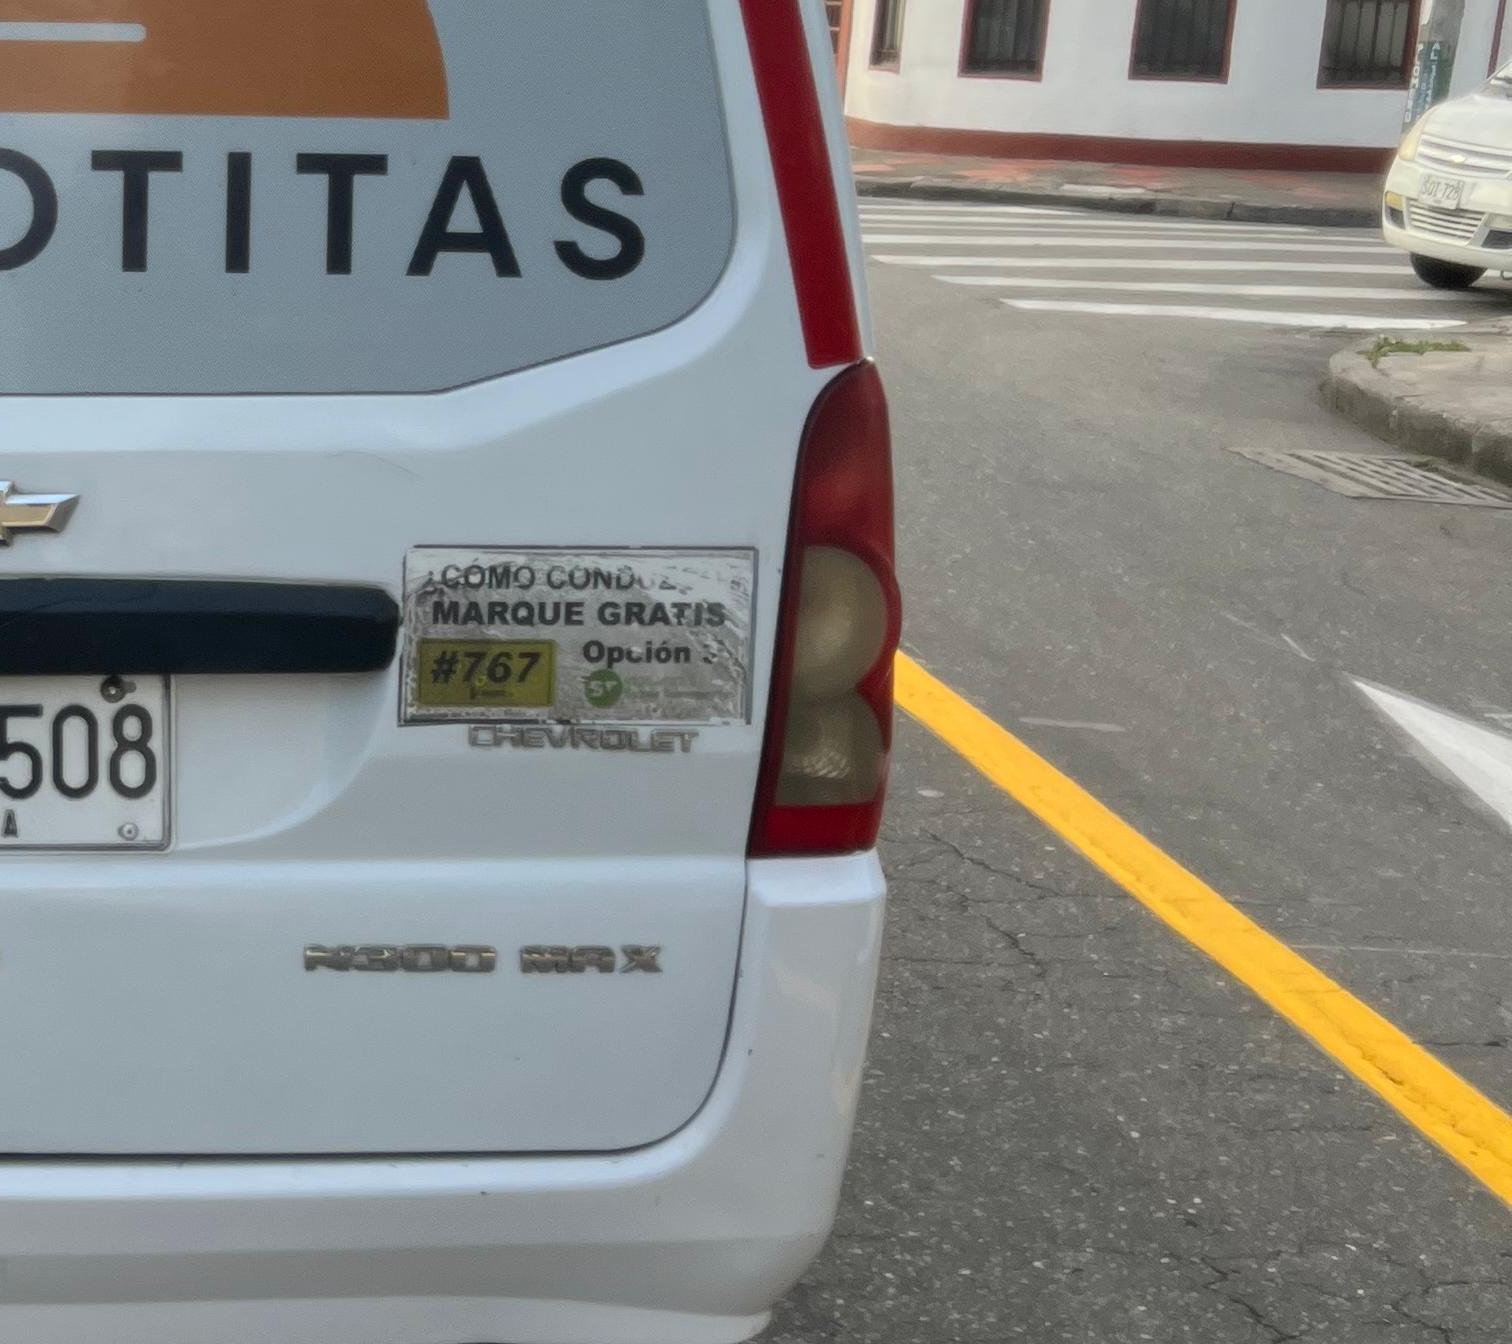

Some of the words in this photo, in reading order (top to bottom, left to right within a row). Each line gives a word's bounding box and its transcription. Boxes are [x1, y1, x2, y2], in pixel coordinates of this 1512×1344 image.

[432, 600, 585, 626] MARQUE
[597, 600, 726, 627] GRATIS
[430, 650, 541, 684] #767
[582, 639, 691, 668] Opción
[468, 724, 699, 753] CHEVROLET
[520, 943, 663, 974] MAX
